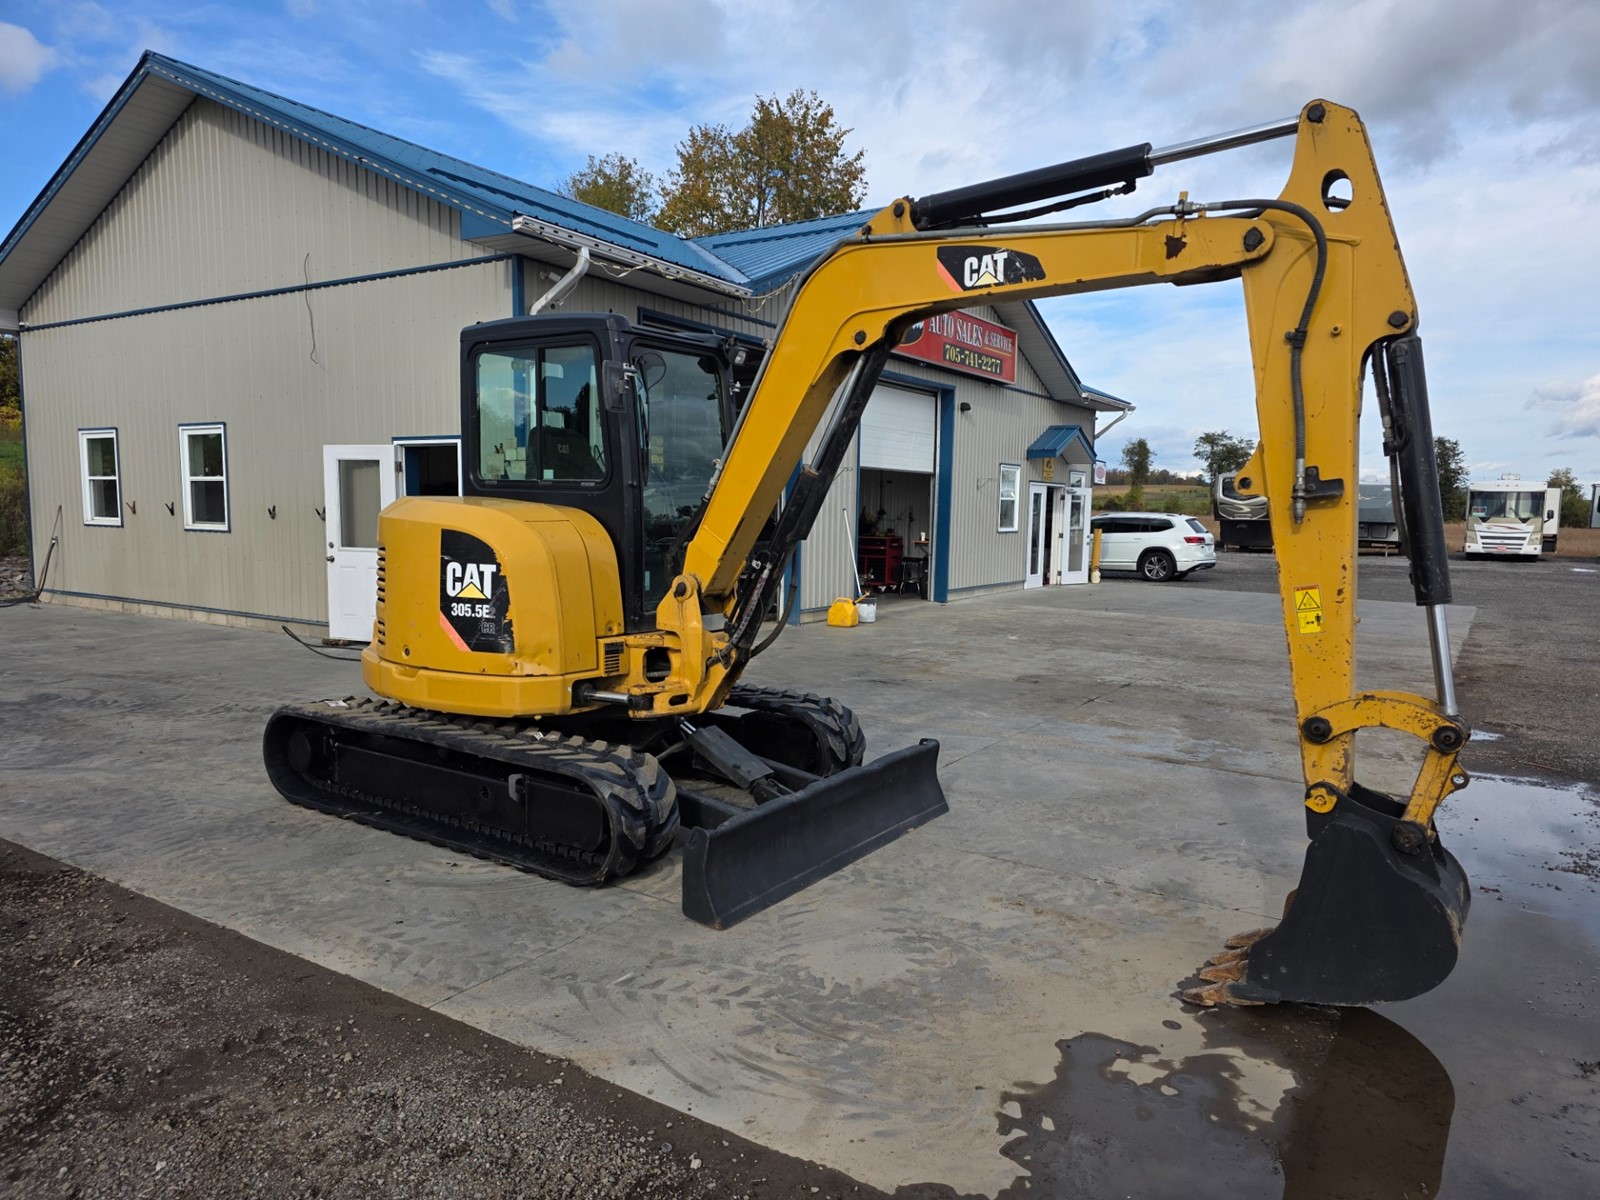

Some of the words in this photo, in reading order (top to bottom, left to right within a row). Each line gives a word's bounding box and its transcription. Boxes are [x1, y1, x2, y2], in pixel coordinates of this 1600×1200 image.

[964, 252, 1008, 287] CAT
[929, 314, 954, 338] AUTO
[956, 319, 983, 347] SALES
[984, 330, 990, 345] &
[990, 332, 1012, 352] SERVICE
[945, 345, 1000, 373] 705-741-2277
[446, 561, 497, 600] CAT
